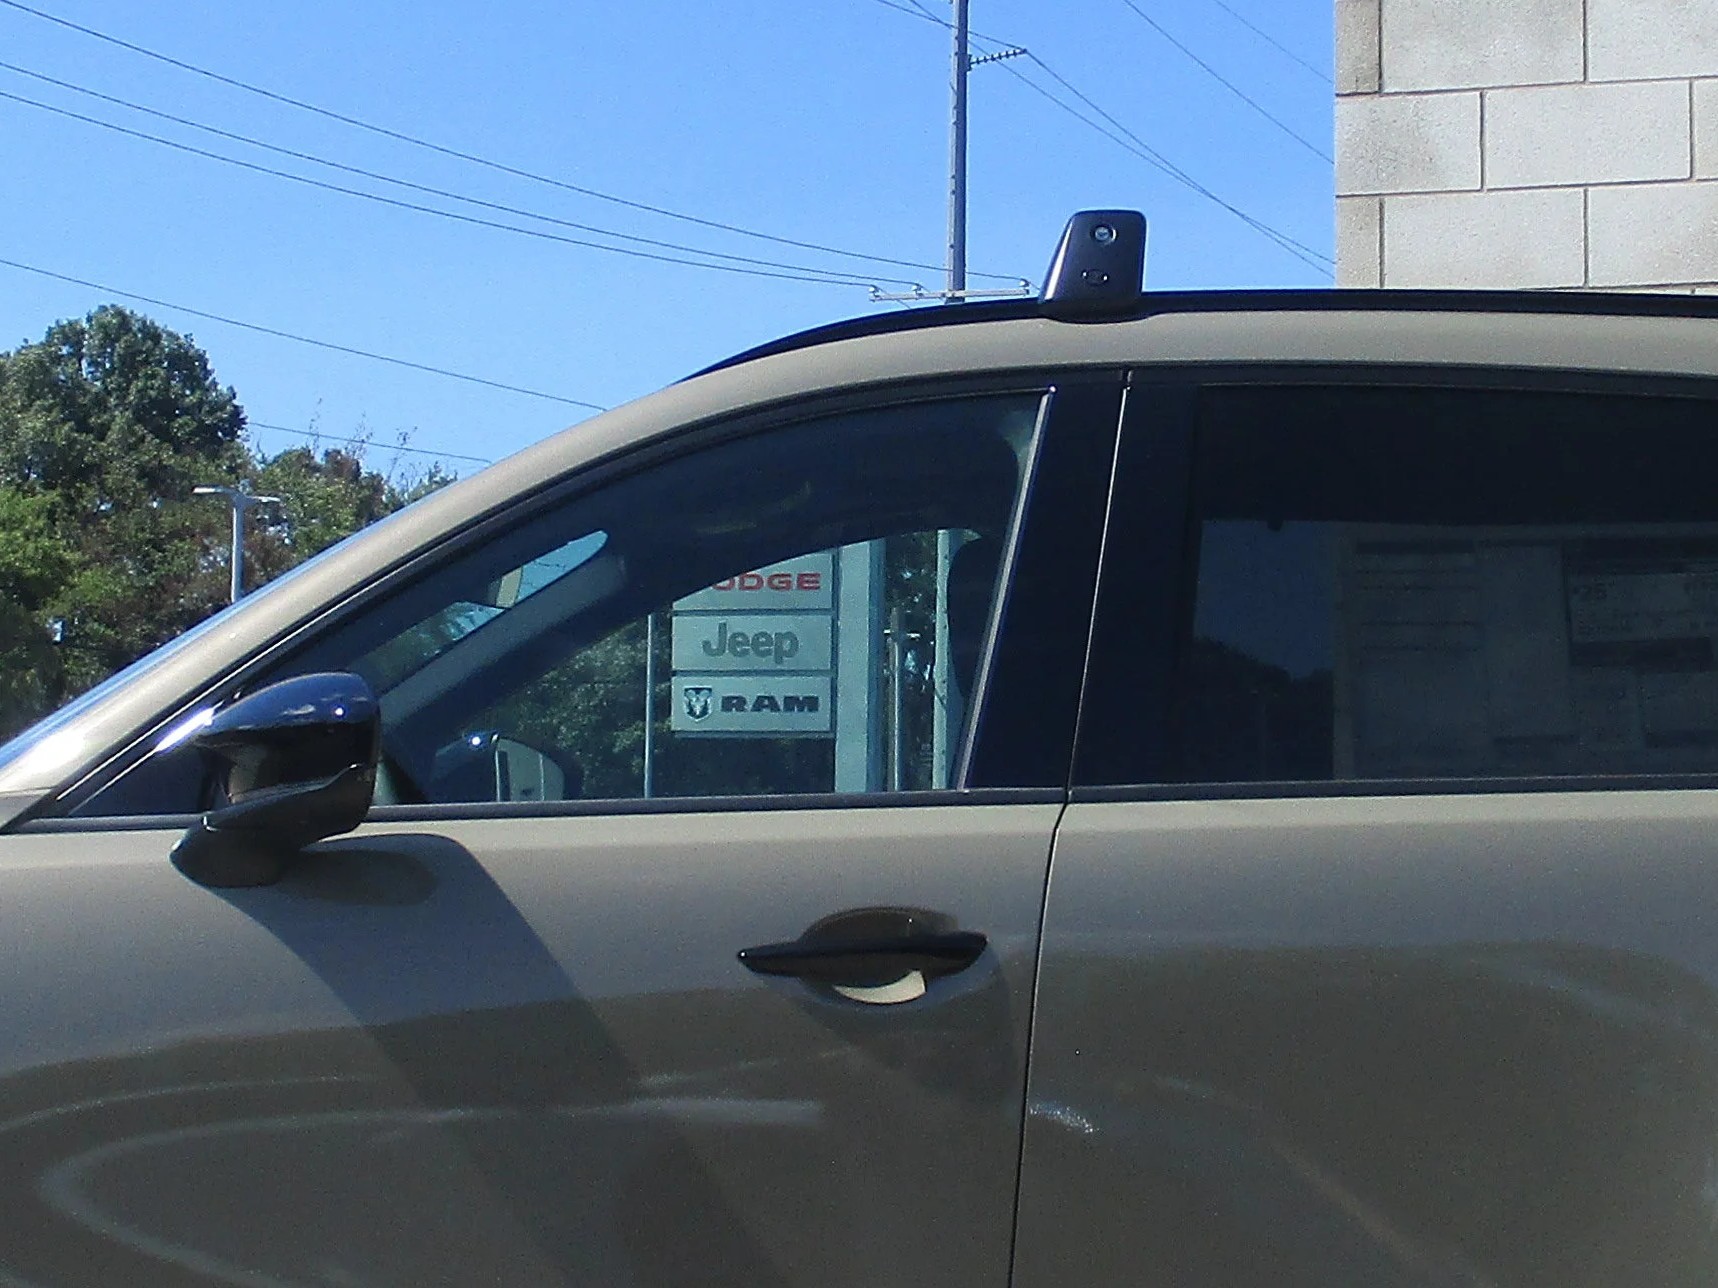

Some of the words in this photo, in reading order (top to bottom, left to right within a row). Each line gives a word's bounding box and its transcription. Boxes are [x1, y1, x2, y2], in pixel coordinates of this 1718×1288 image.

[711, 573, 821, 591] ODGE
[702, 621, 800, 665] Jeep
[721, 695, 820, 713] RAM
